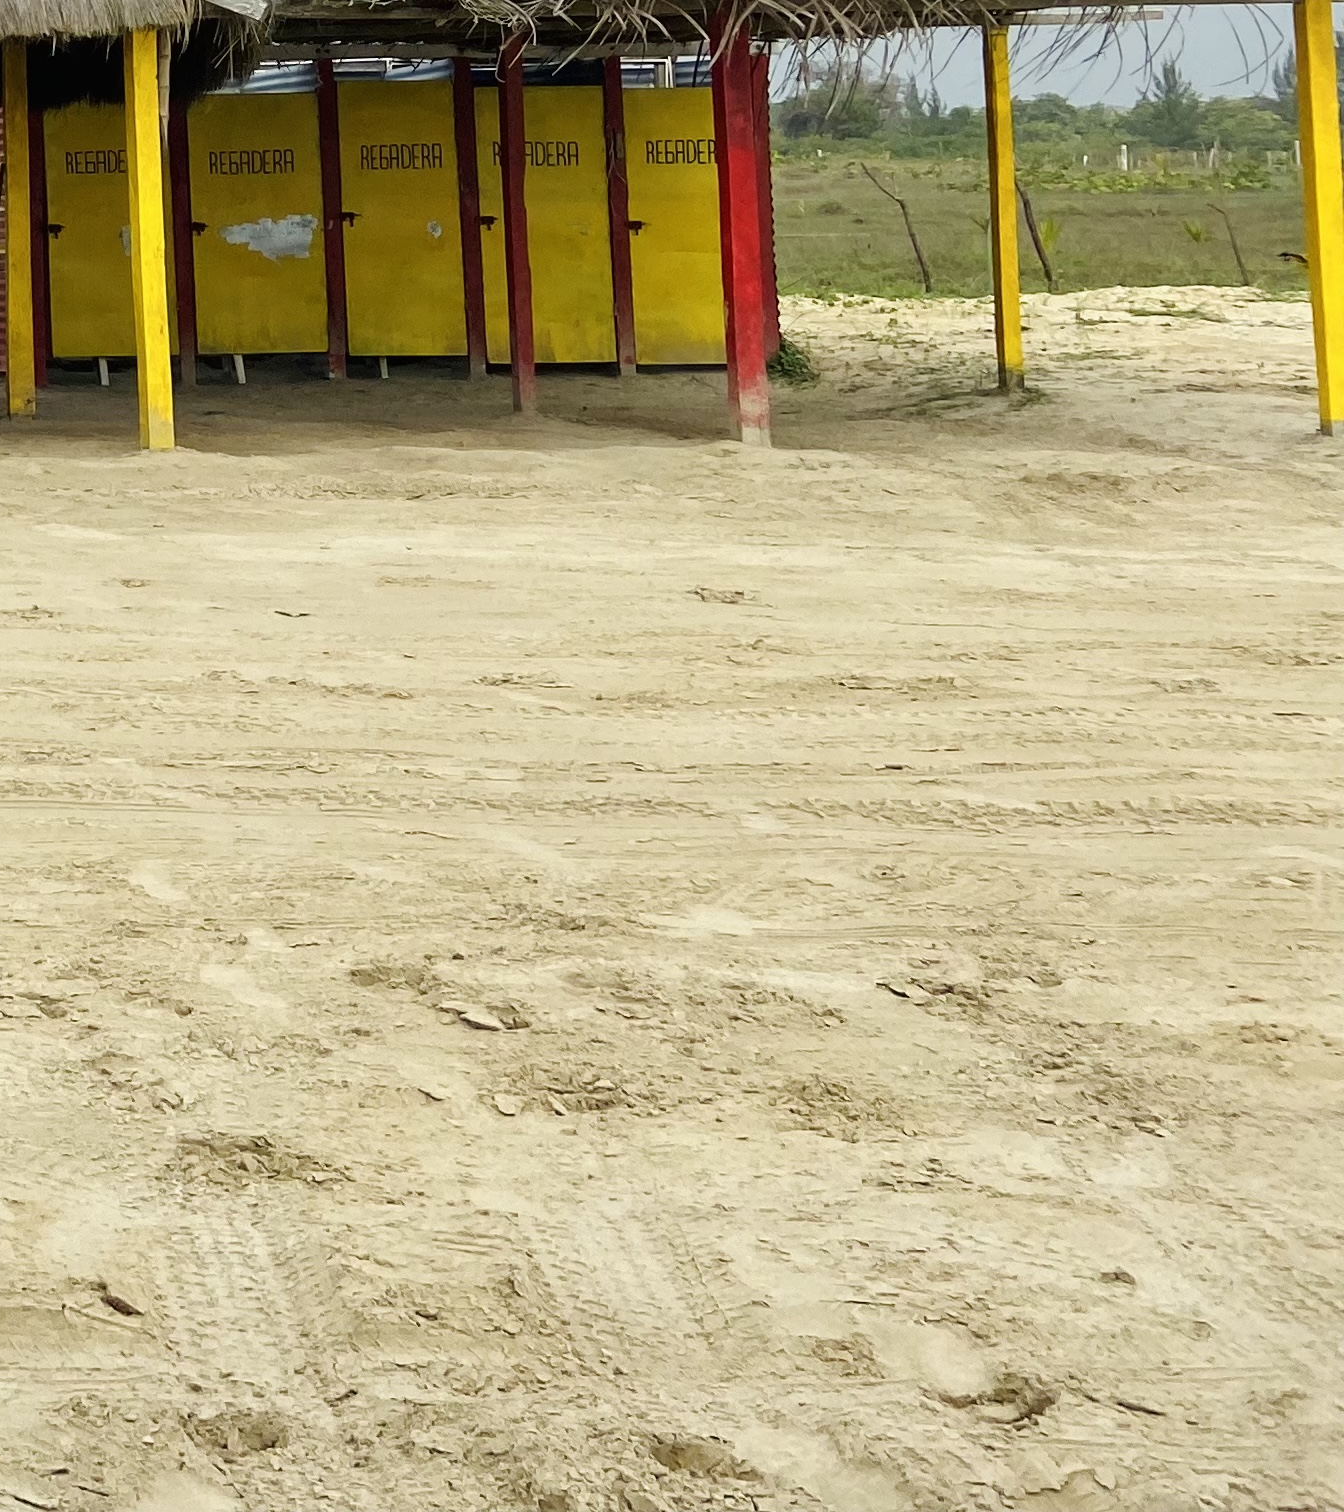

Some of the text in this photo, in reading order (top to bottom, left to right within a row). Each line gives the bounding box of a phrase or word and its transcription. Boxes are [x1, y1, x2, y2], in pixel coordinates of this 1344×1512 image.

[65, 149, 126, 175] REGADE
[208, 148, 295, 175] REGADERA
[360, 142, 443, 170] REGADERA
[645, 138, 717, 165] REGADER
